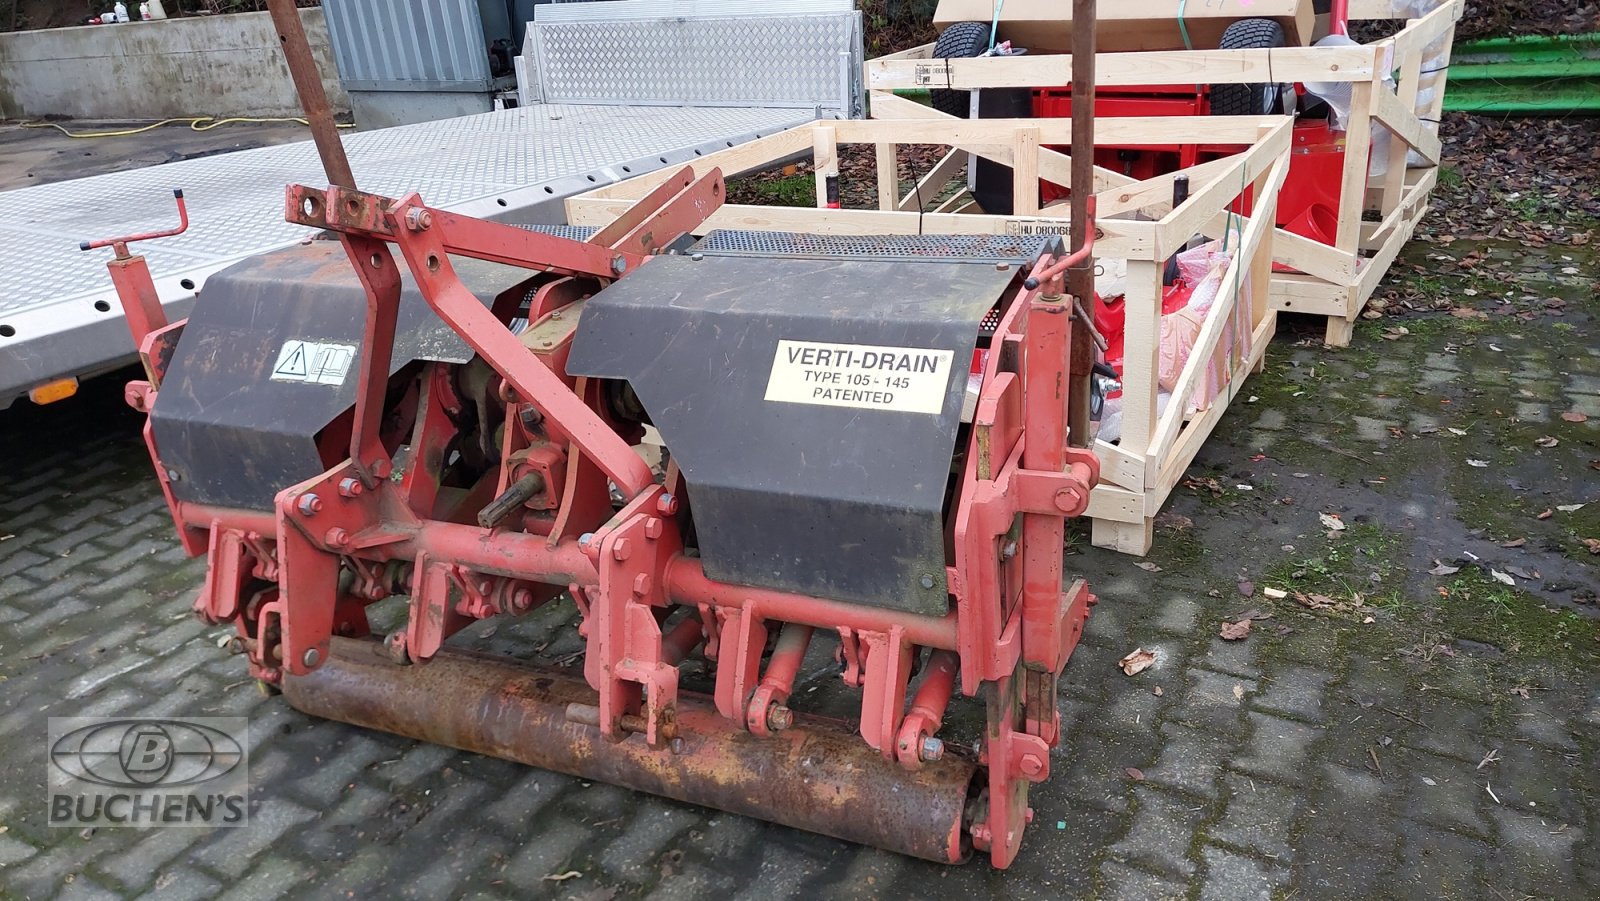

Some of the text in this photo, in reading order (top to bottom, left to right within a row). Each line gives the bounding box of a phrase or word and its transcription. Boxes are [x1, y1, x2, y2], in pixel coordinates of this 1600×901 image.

[1021, 225, 1032, 234] HU
[788, 346, 939, 373] VERTI-DRAIN
[804, 370, 842, 384] TYPE
[847, 374, 871, 386] 105
[885, 377, 910, 389] 145
[813, 387, 894, 404] PATENTED
